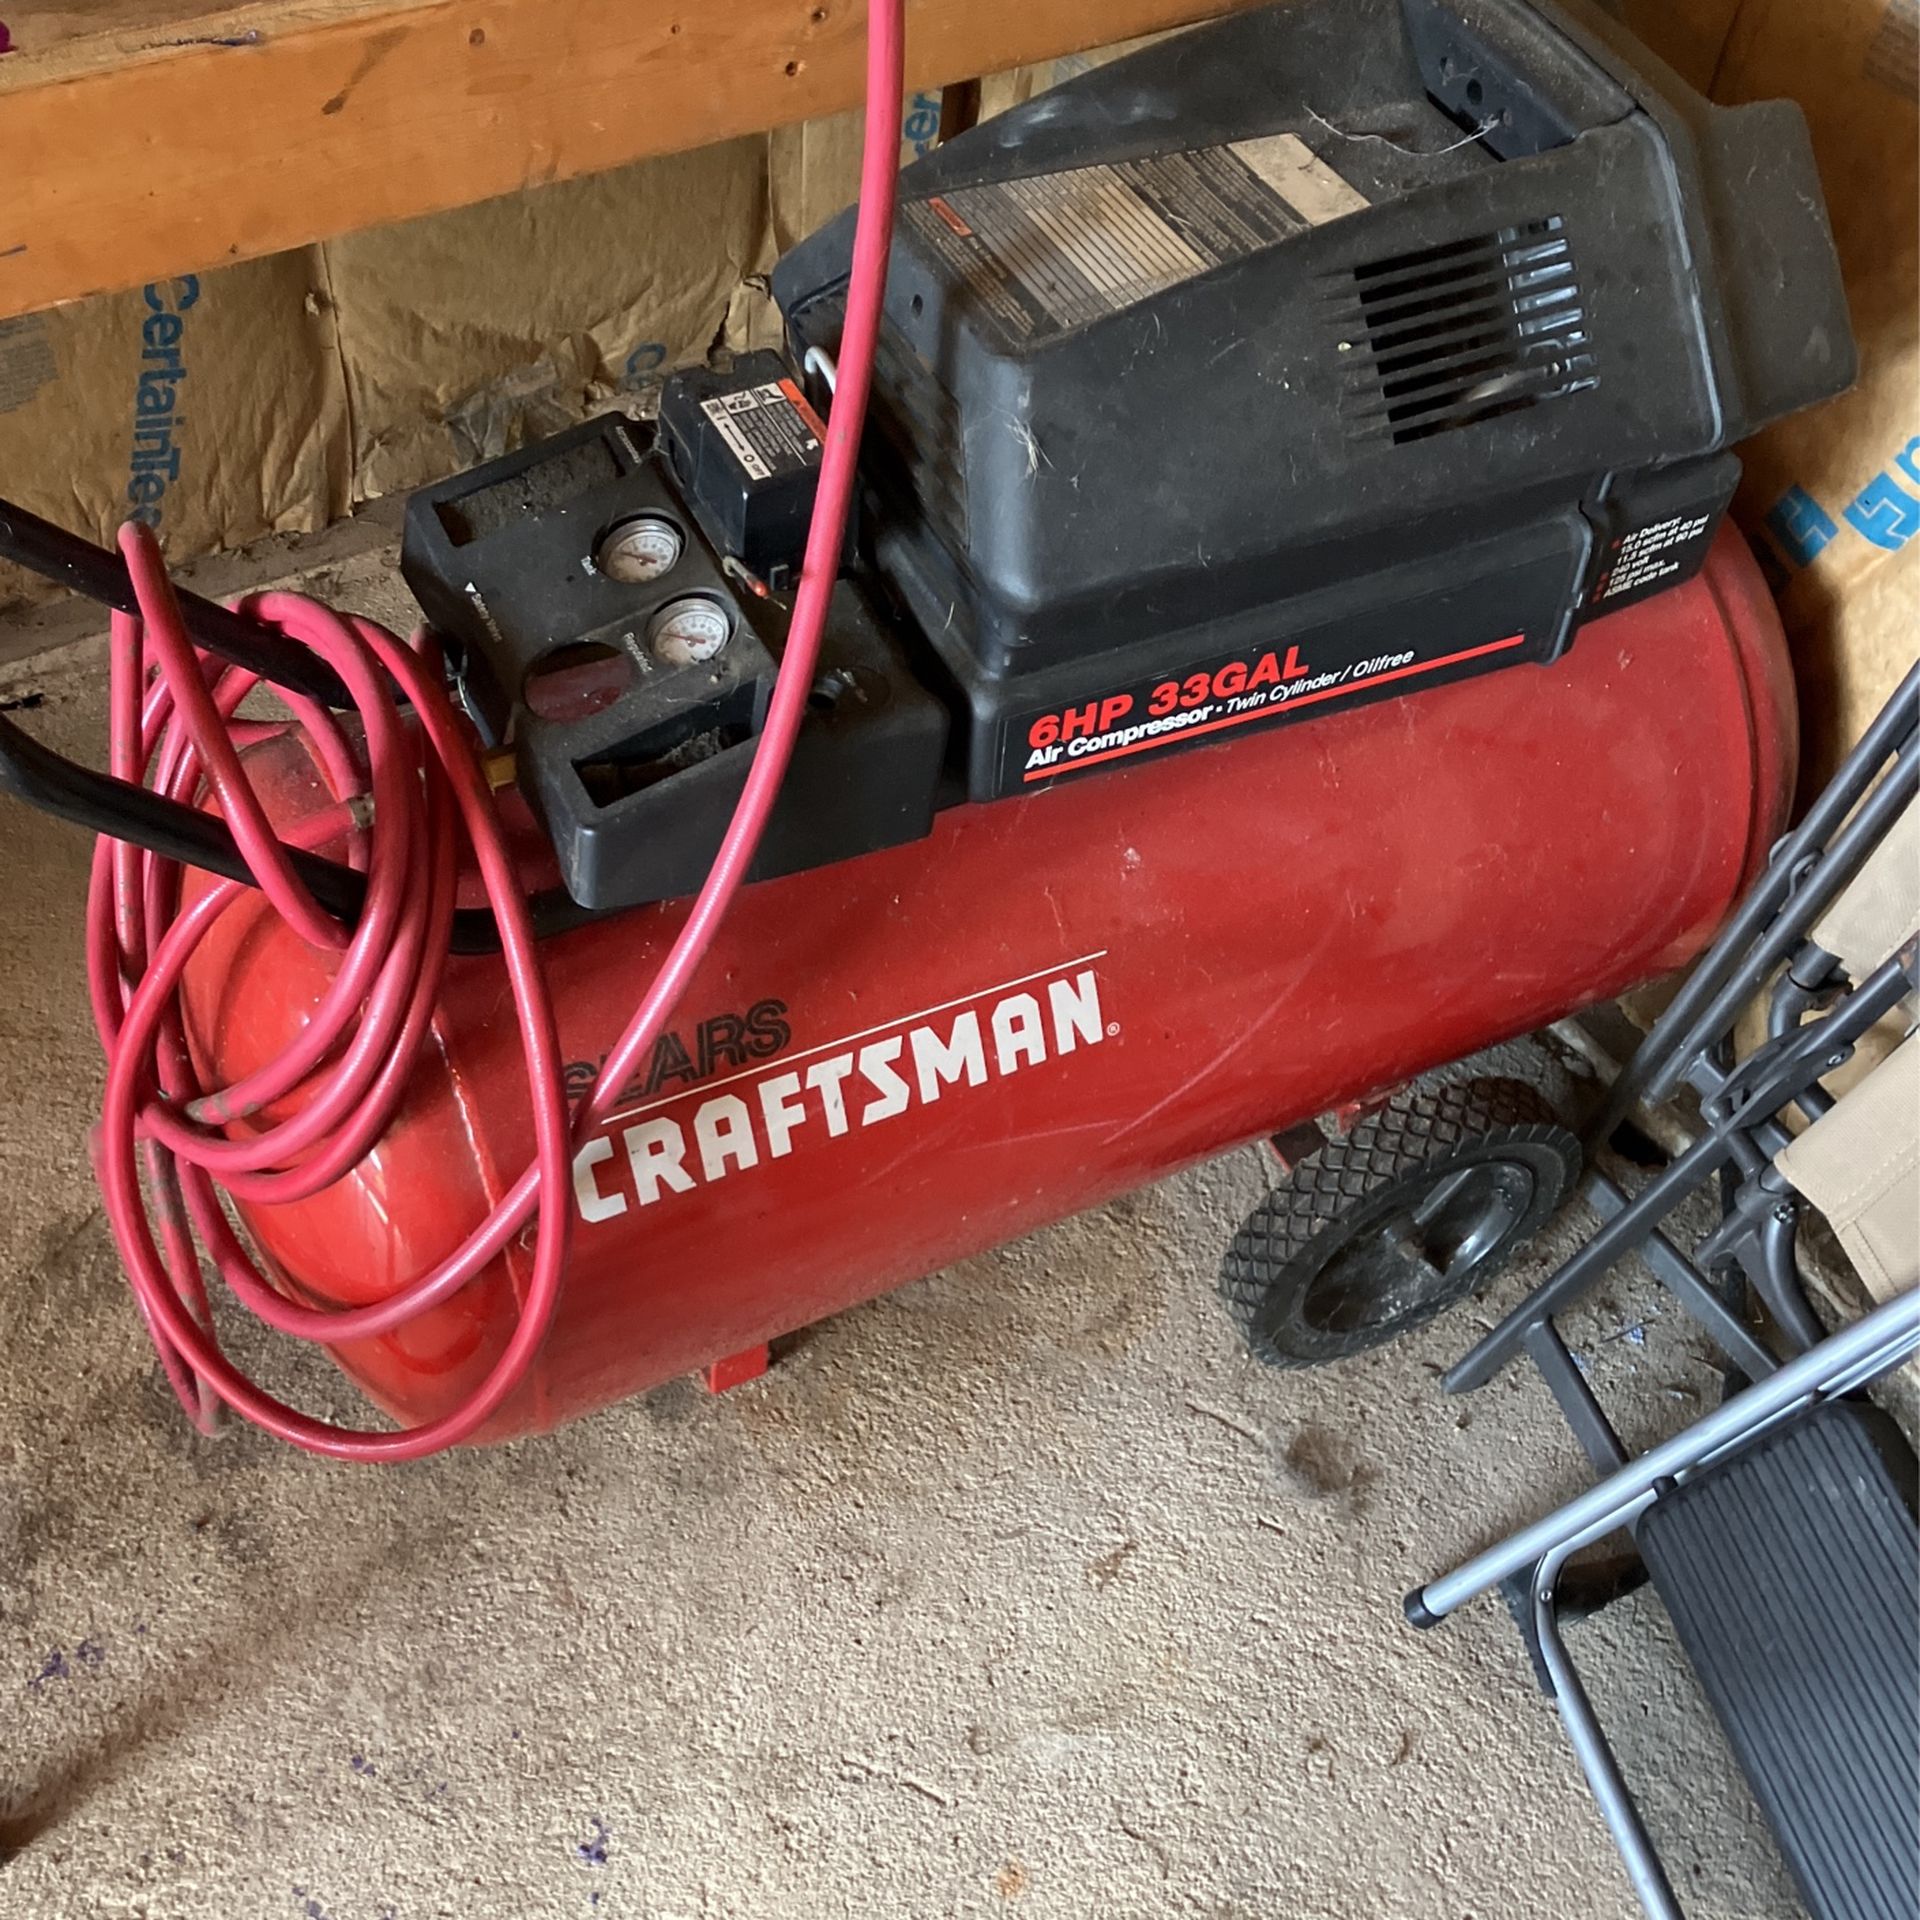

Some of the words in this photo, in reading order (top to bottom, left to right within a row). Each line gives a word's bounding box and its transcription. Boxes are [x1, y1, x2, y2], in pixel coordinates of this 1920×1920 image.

[1622, 533, 1638, 545] Air
[1638, 542, 1663, 557] scfm
[1663, 537, 1675, 548] at
[1675, 531, 1689, 543] 90
[1687, 525, 1705, 539] psi
[1642, 531, 1667, 546] scfm
[1667, 526, 1679, 537] at
[1679, 520, 1693, 531] 40
[1692, 513, 1710, 528] psi
[1603, 579, 1633, 599] ASME
[1633, 571, 1658, 586] code
[1658, 561, 1680, 576] tank
[1609, 573, 1627, 587] 125
[1626, 566, 1643, 581] psi
[1611, 563, 1631, 577] 240
[1631, 555, 1650, 569] volt
[1025, 744, 1063, 770] Air
[1067, 704, 1215, 757] Compressor
[1226, 691, 1267, 714] Twin
[1269, 671, 1342, 702] Cylinder
[1352, 649, 1415, 678] Oilfree
[1028, 693, 1134, 750] 6HP
[1148, 645, 1310, 717] 33GAL
